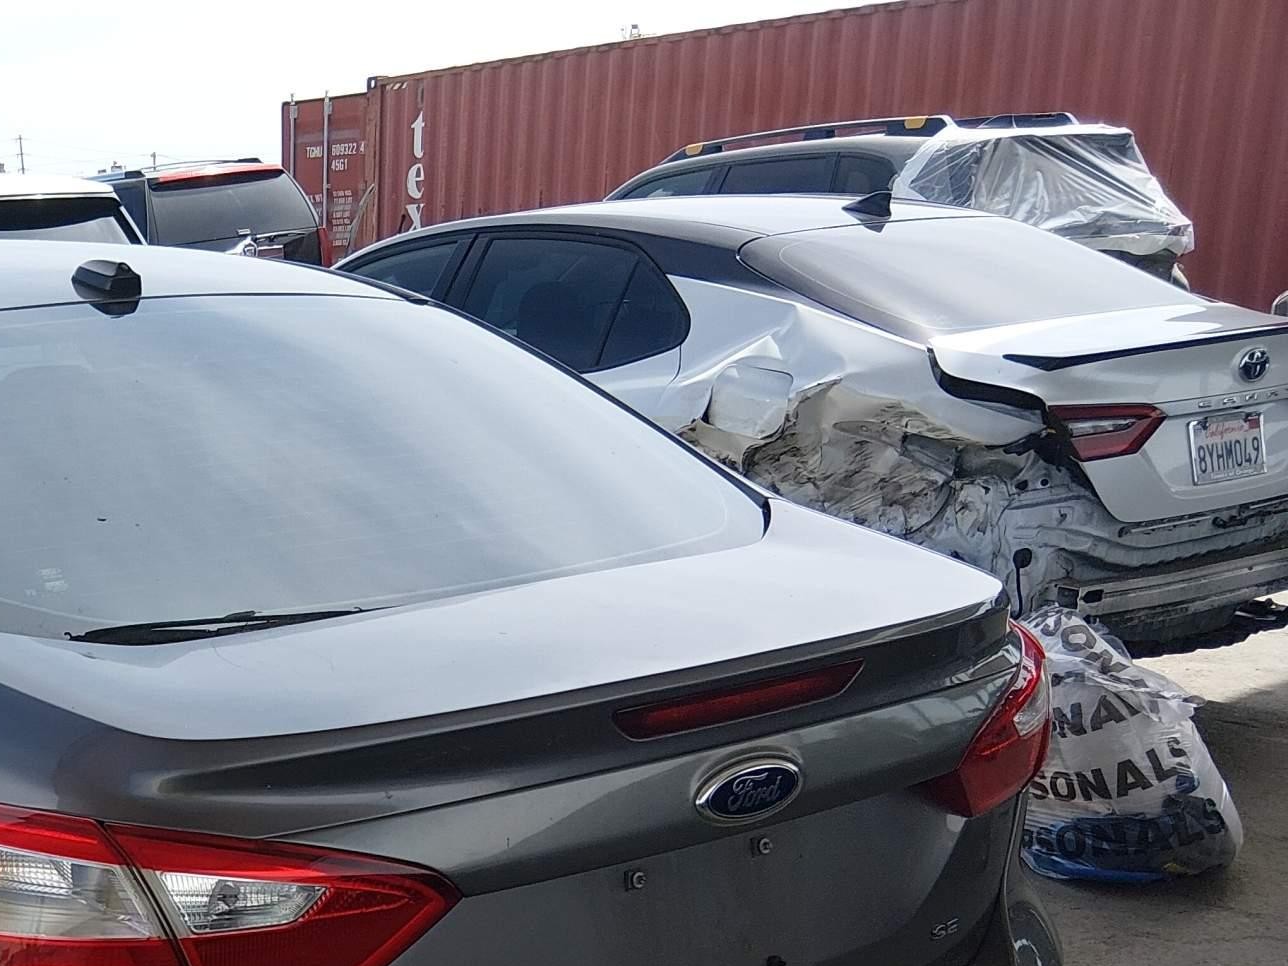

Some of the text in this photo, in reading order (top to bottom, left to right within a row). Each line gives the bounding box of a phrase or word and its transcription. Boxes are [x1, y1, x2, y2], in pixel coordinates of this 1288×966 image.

[332, 143, 357, 156] 609322
[359, 141, 365, 155] 4
[331, 159, 348, 171] 45G1
[1197, 436, 1260, 474] 8YHM049
[728, 772, 782, 811] Ford
[931, 918, 959, 940] SE
